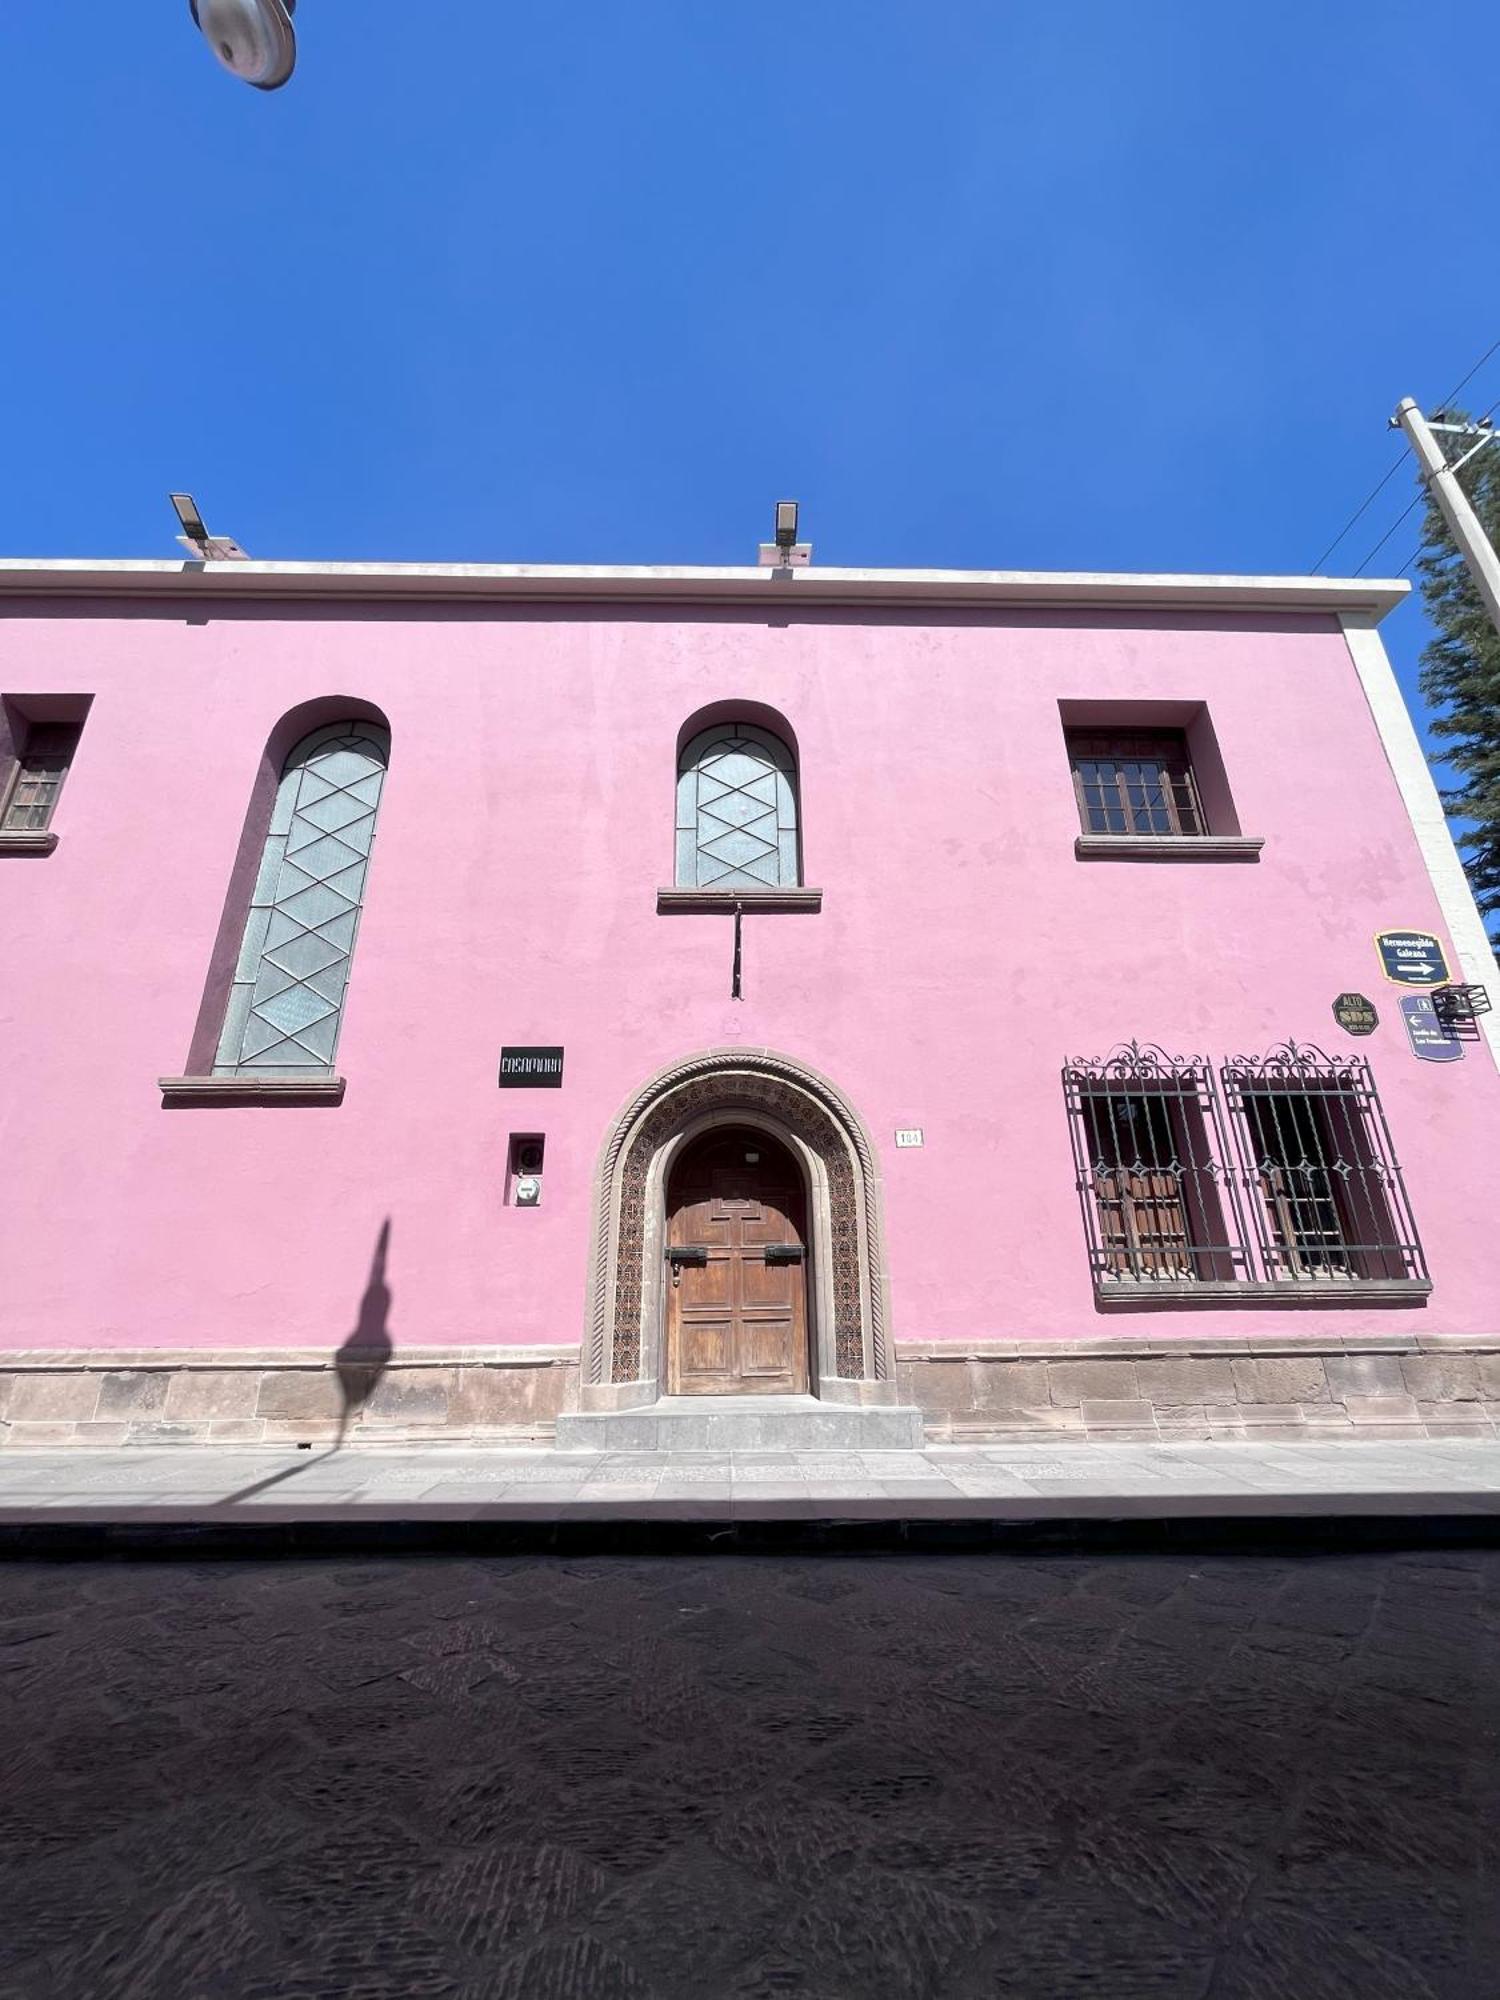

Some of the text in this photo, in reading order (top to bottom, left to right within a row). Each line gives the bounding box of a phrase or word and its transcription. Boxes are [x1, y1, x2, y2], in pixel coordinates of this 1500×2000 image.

[1382, 936, 1434, 949] Hermenegildo
[1396, 948, 1428, 958] Galeana
[1343, 995, 1362, 1007] ALTO
